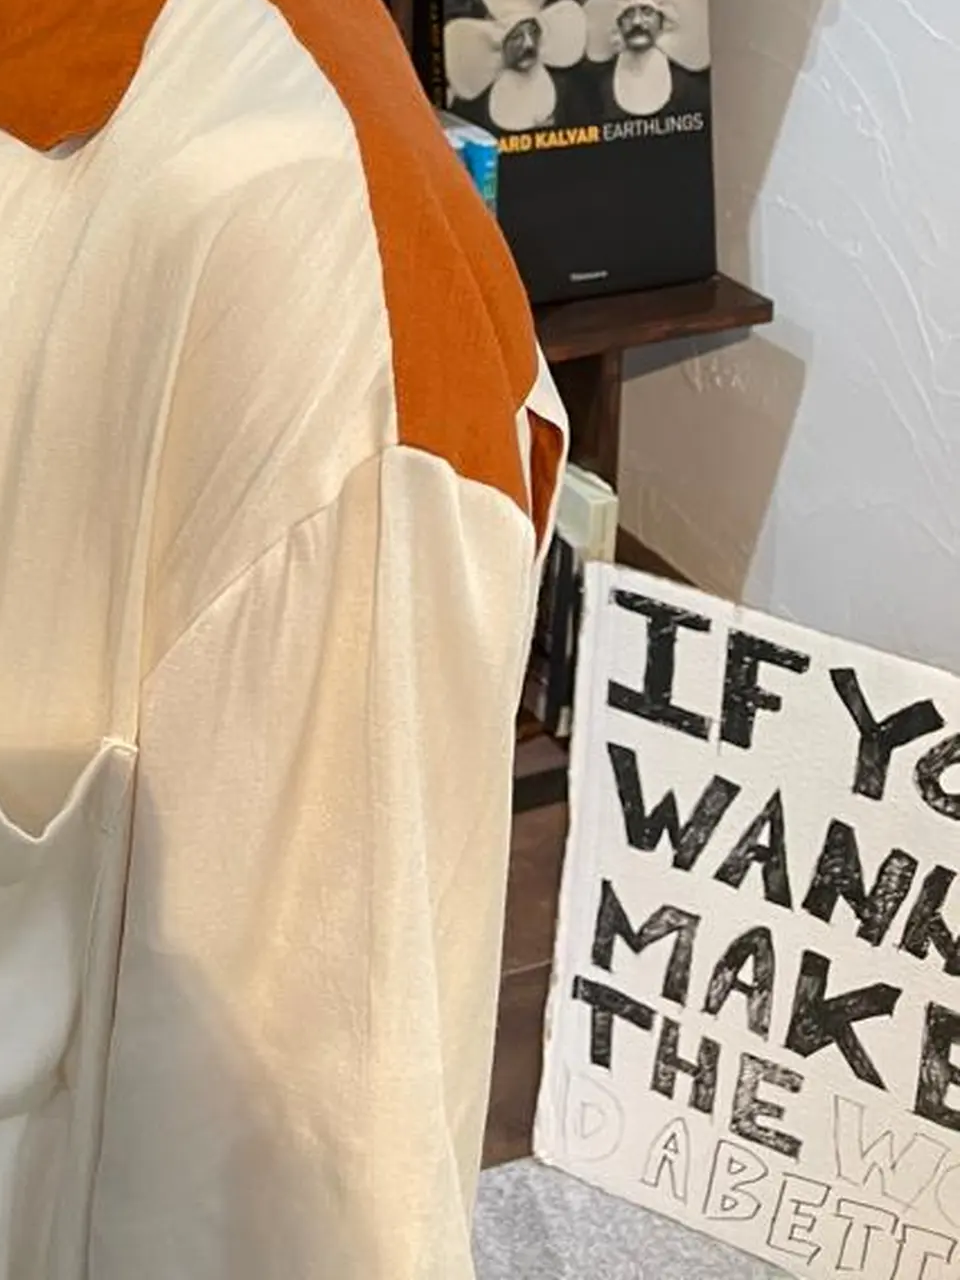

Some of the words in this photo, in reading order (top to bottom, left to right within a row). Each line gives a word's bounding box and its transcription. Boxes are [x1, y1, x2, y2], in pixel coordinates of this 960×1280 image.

[535, 125, 600, 149] KALVAR
[603, 112, 705, 141] EARTHLINGS
[606, 588, 811, 750] IF
[572, 974, 806, 1163] THE
